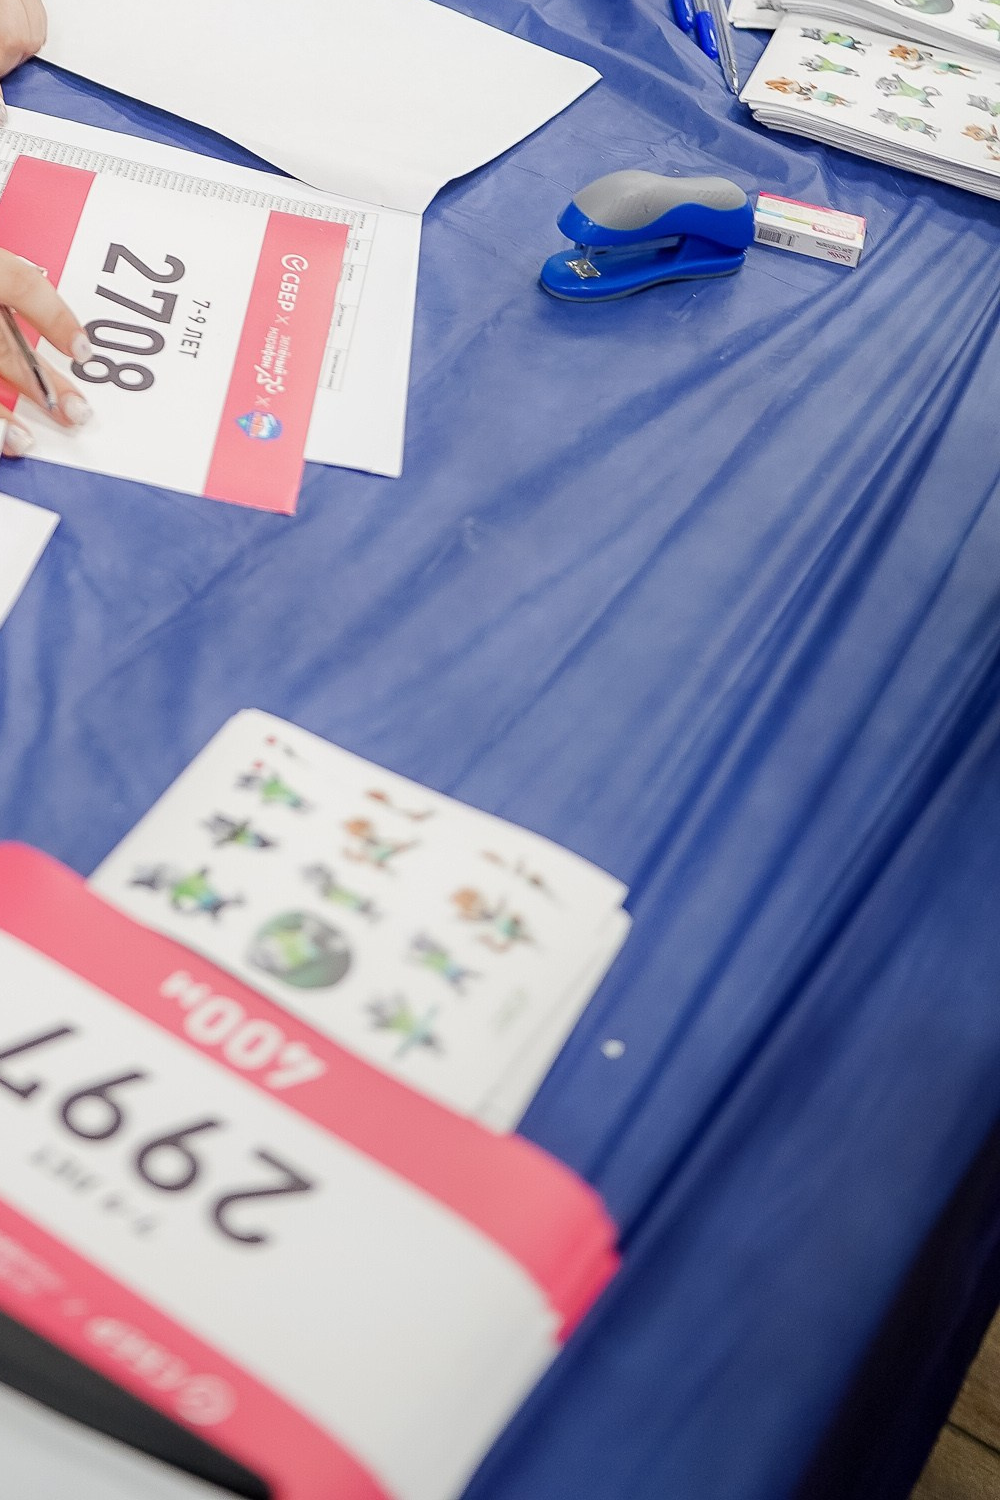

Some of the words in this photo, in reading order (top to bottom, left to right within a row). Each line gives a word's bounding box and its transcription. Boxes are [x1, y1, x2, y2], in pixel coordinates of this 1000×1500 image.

[277, 273, 301, 312] СБЕР
[71, 242, 186, 391] 2708
[188, 299, 211, 325] 7-9
[178, 326, 204, 359] ЛЕТ
